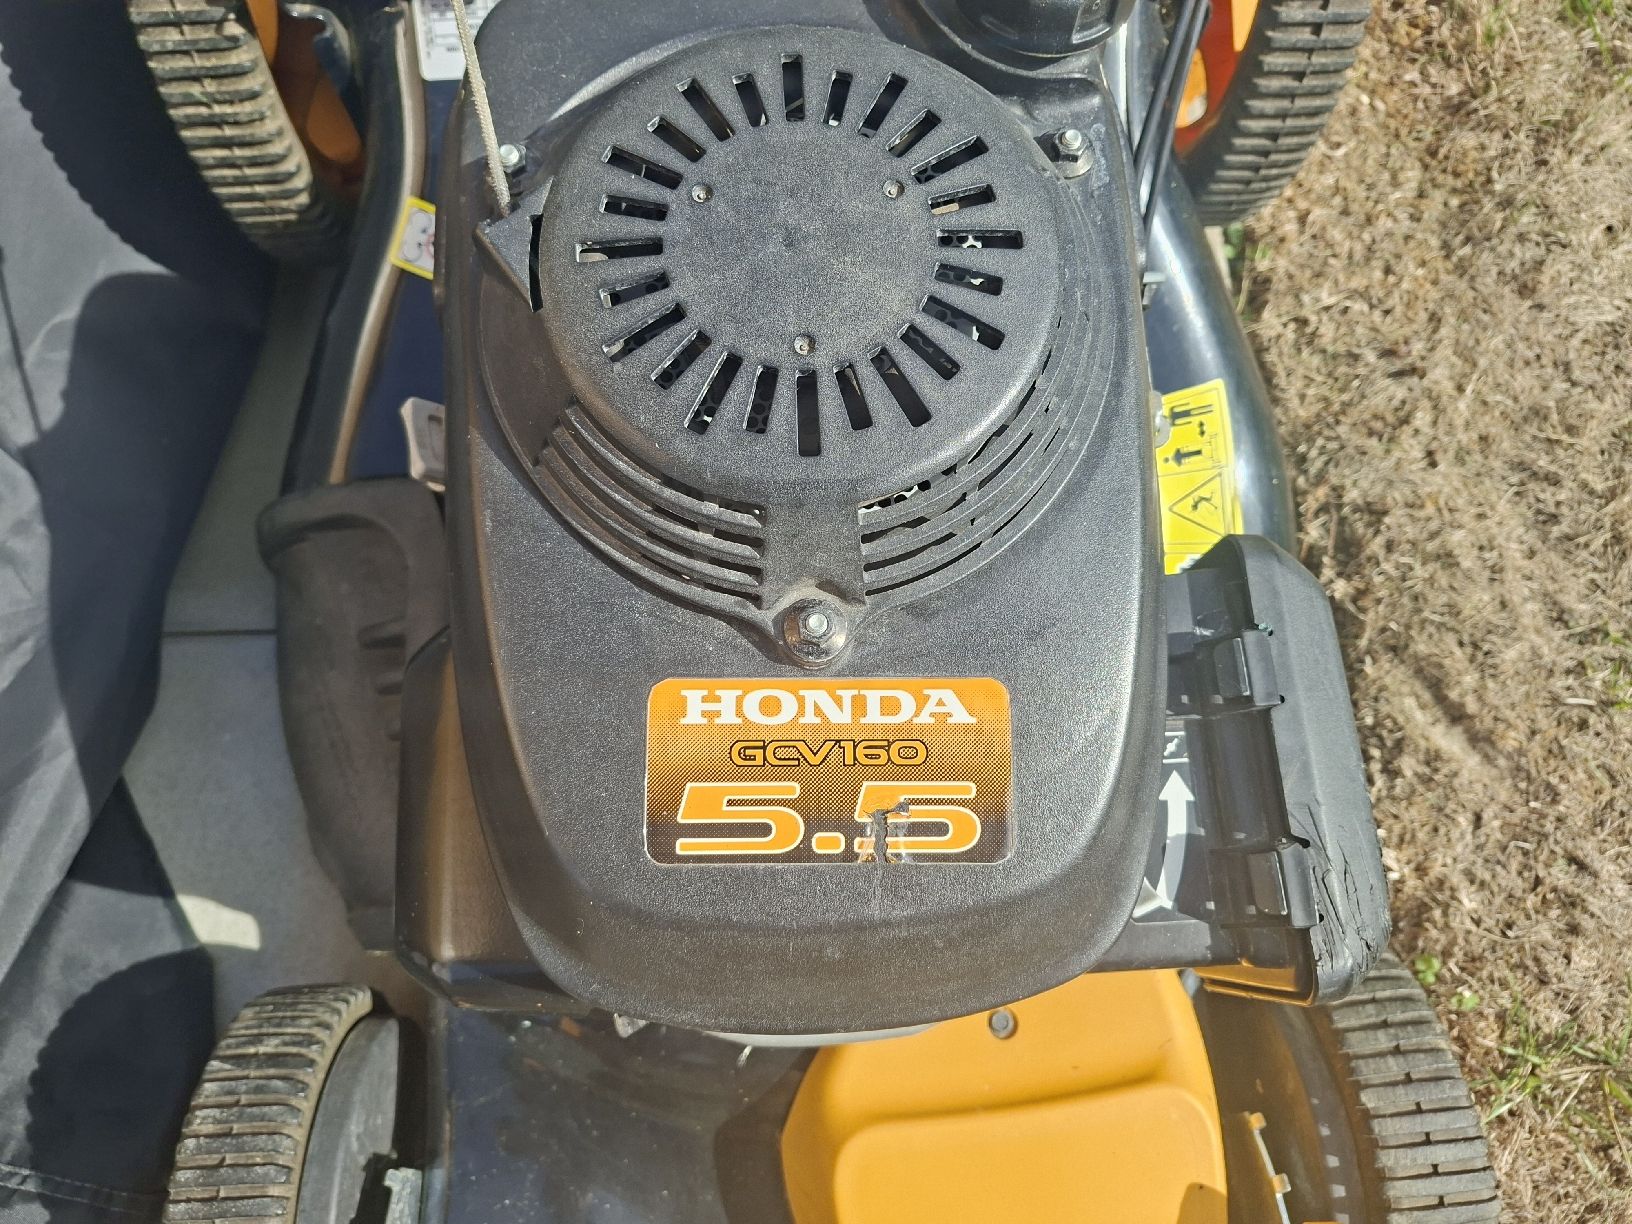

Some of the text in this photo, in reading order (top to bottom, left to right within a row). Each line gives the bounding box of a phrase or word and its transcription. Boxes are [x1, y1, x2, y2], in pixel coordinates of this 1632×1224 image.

[680, 689, 976, 725] HONDA
[730, 739, 928, 767] GCV160
[675, 781, 982, 855] 5.5
